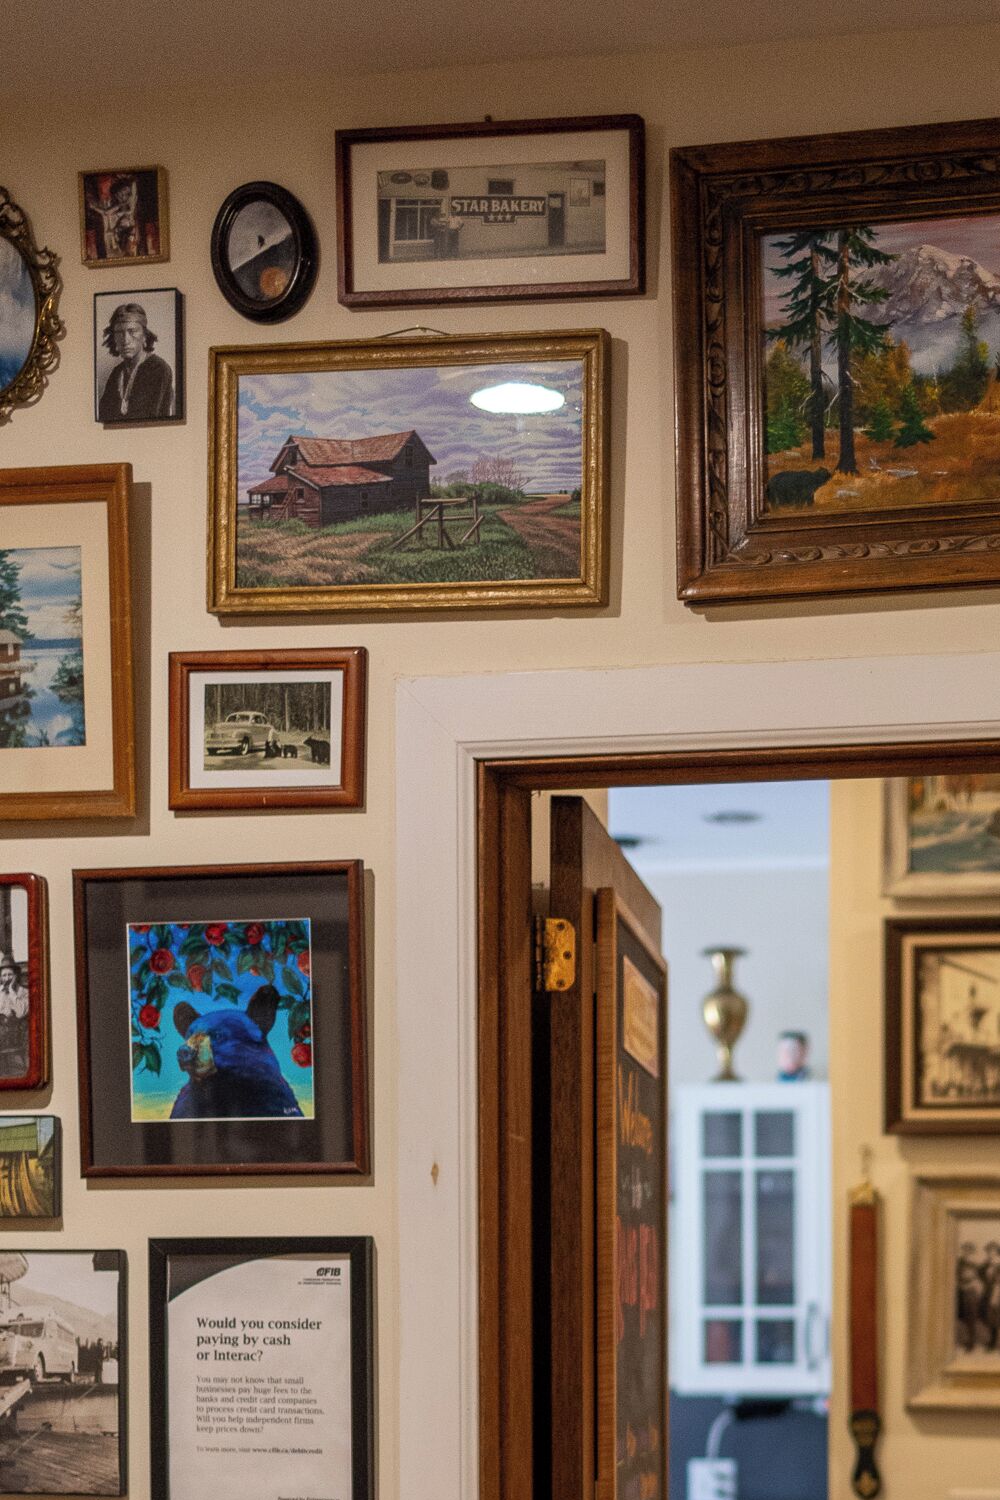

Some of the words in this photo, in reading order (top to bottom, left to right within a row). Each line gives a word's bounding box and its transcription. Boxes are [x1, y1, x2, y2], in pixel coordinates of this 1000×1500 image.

[451, 200, 489, 213] STAR
[491, 199, 545, 213] BAKERY
[196, 1317, 237, 1329] Would
[241, 1320, 264, 1332] you
[267, 1318, 322, 1330] consider
[196, 1334, 239, 1347] paying
[243, 1334, 259, 1347] by
[262, 1334, 291, 1346] cash
[196, 1352, 210, 1361] or
[213, 1350, 263, 1362] Interac?
[196, 1376, 211, 1384] You
[245, 1376, 265, 1384] know
[267, 1376, 282, 1384] that
[284, 1377, 304, 1385] small
[196, 1385, 236, 1393] businesses
[238, 1387, 252, 1395] pay
[253, 1386, 271, 1395] huge
[273, 1386, 288, 1394] fees
[196, 1395, 218, 1403] banks
[236, 1396, 257, 1404] credit
[259, 1396, 276, 1404] card
[277, 1398, 317, 1406] companies
[236, 1406, 257, 1414] credit
[259, 1406, 276, 1414] card
[277, 1407, 325, 1415] transactions.
[196, 1415, 211, 1423] Will
[212, 1417, 226, 1425] you
[228, 1415, 244, 1425] help
[245, 1416, 292, 1425] independent
[294, 1416, 314, 1424] firms
[196, 1425, 214, 1434] keep
[215, 1426, 238, 1434] prices
[239, 1425, 264, 1433] down?
